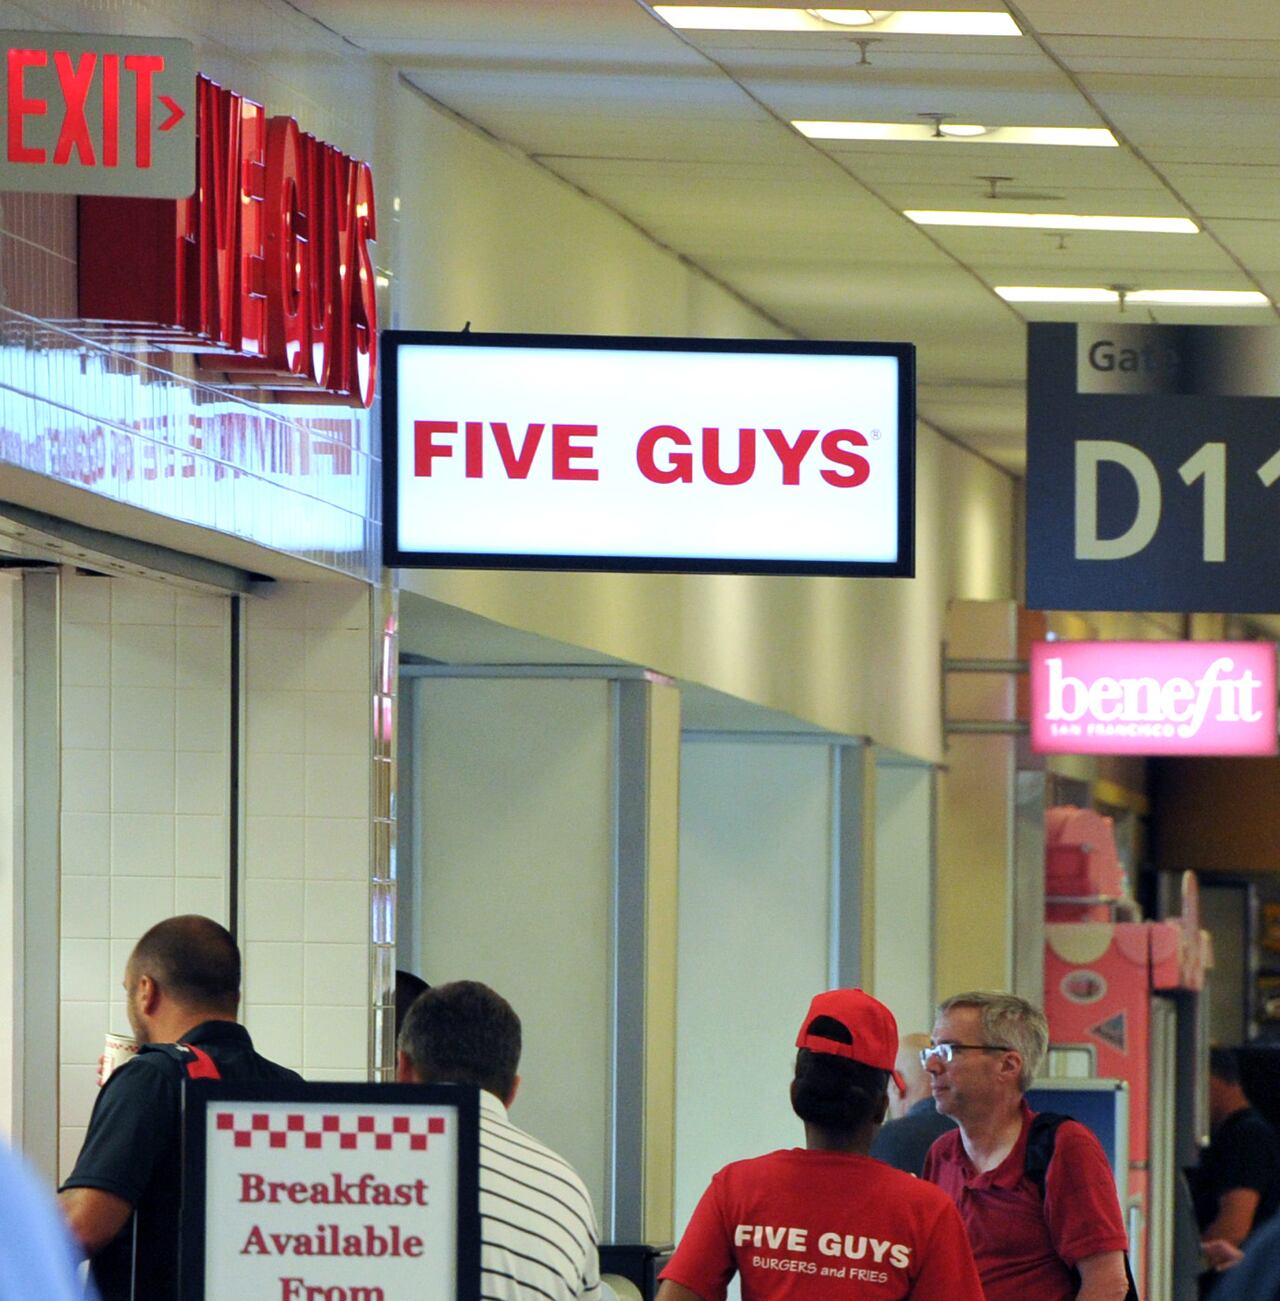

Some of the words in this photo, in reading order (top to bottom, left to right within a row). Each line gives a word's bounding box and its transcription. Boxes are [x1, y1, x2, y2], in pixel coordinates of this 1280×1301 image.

[7, 48, 165, 169] EXIT
[414, 420, 599, 481] FIVE
[636, 425, 872, 489] GUYS
[1045, 657, 1263, 739] benefit
[238, 1172, 429, 1206] Breakfast
[239, 1224, 425, 1257] Available
[735, 1225, 808, 1252] FIVE
[818, 1232, 911, 1268] GUYS
[752, 1256, 817, 1274] BURGERS
[820, 1266, 846, 1278] and
[850, 1267, 888, 1284] FRIES
